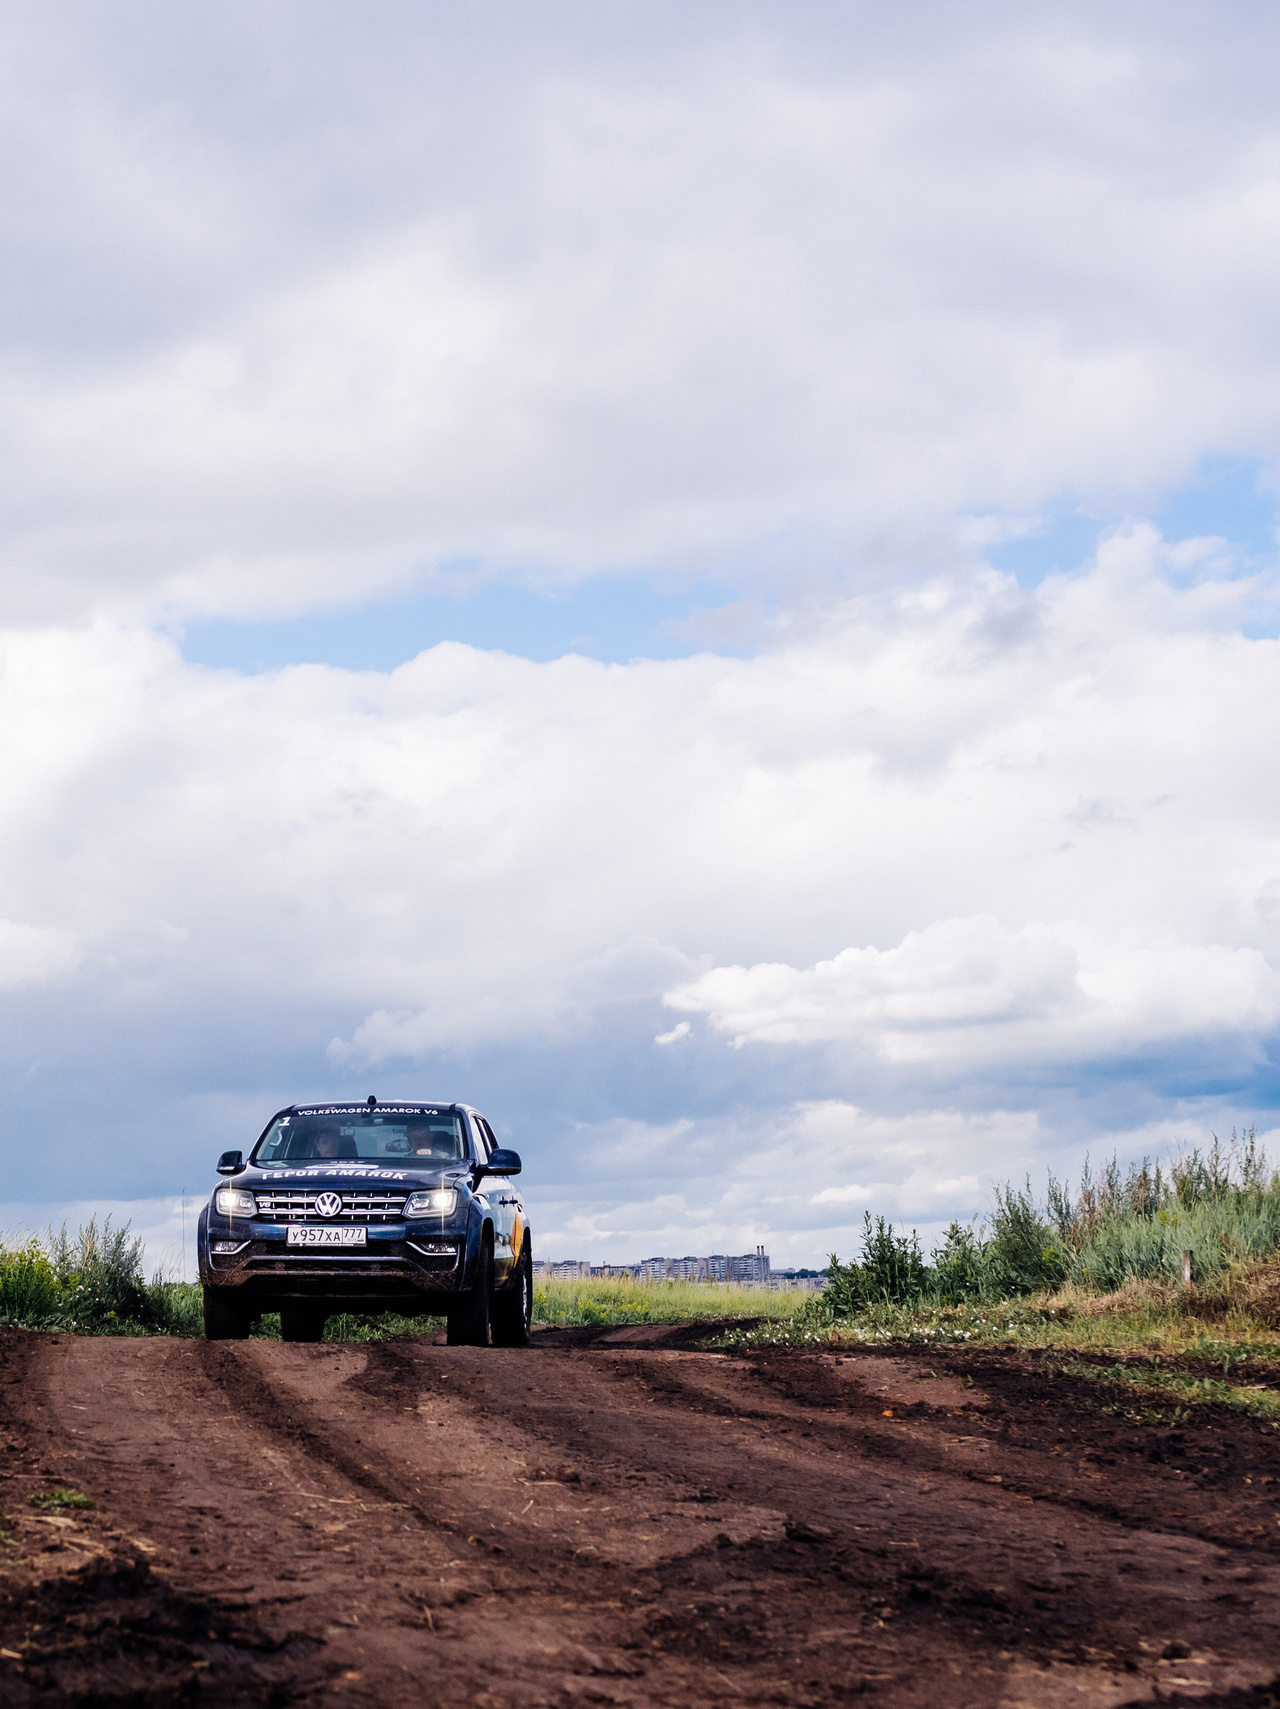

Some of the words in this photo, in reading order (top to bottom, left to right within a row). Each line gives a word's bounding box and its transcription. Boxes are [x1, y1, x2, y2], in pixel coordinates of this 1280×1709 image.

[298, 1107, 370, 1116] VOLKSWAGEN
[279, 1116, 291, 1126] 1
[325, 1169, 408, 1180] AMAROK
[343, 1228, 363, 1238] 777
